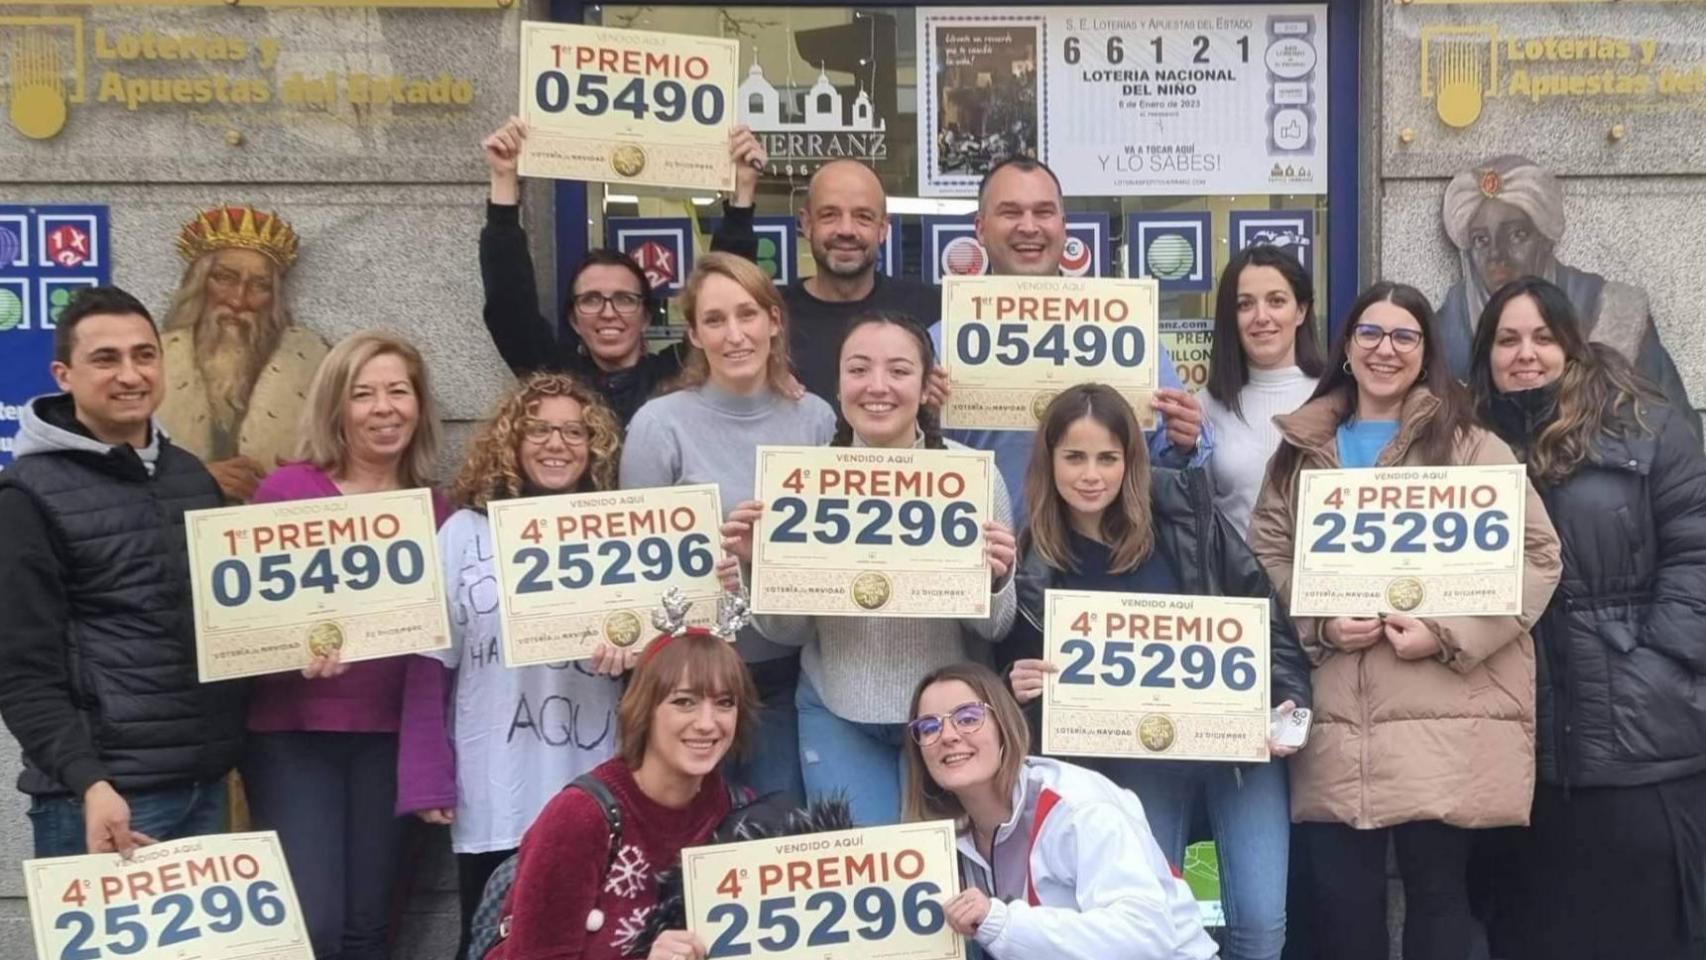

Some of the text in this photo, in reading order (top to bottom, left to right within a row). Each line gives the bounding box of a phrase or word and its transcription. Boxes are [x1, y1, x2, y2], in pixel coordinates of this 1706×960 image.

[1149, 18, 1195, 30] APUESTAS
[1197, 19, 1214, 30] DEL
[1216, 17, 1253, 30] ESTADO
[257, 37, 280, 69] y
[575, 46, 709, 80] PREMIO
[1640, 38, 1657, 66] y
[1122, 81, 1197, 96] DEL NIÑO
[1155, 69, 1236, 81] NACIONAL
[1508, 69, 1650, 104] Apuestas
[100, 71, 475, 110] Apuestas del Estado
[535, 70, 725, 125] 05490
[1126, 101, 1136, 109] de
[1139, 100, 1164, 109] Enero
[1167, 100, 1178, 109] de
[1180, 100, 1201, 109] 2023
[1098, 154, 1222, 173] Y LO SABES!
[1124, 143, 1195, 155] VA A TOCAR AQUÍ
[997, 297, 1129, 323] PREMIO
[957, 323, 1145, 368] 05490
[836, 453, 914, 465] VENDIDO AQUÍ
[819, 469, 966, 499] PREMIO
[1374, 471, 1448, 481] VENDIDO AQUÍ
[569, 494, 645, 509] VENDIDO AQUÍ
[1358, 485, 1498, 510] PREMIO
[253, 513, 401, 554] PREMIO
[556, 506, 696, 542] PREMIO
[769, 497, 979, 547] 25296
[1310, 510, 1510, 554] 25296
[211, 539, 425, 608] 05490
[512, 533, 714, 595] 25296
[808, 587, 846, 595] NAVIDAD
[922, 589, 965, 597] DICIEMBRE
[1120, 598, 1194, 610] VENDIDO AQUÍ
[1105, 612, 1244, 644] PREMIO
[1058, 639, 1257, 692] 25296
[1056, 726, 1087, 735] LOTERÍA
[1097, 728, 1133, 737] NAVIDAD
[1205, 732, 1247, 740] DICIEMBRE
[776, 834, 864, 855] VENDIDO AQUÍ
[101, 853, 260, 905] PREMIO
[758, 849, 926, 896] PREMIO
[55, 880, 287, 960] 25296
[706, 881, 945, 960] 25296
